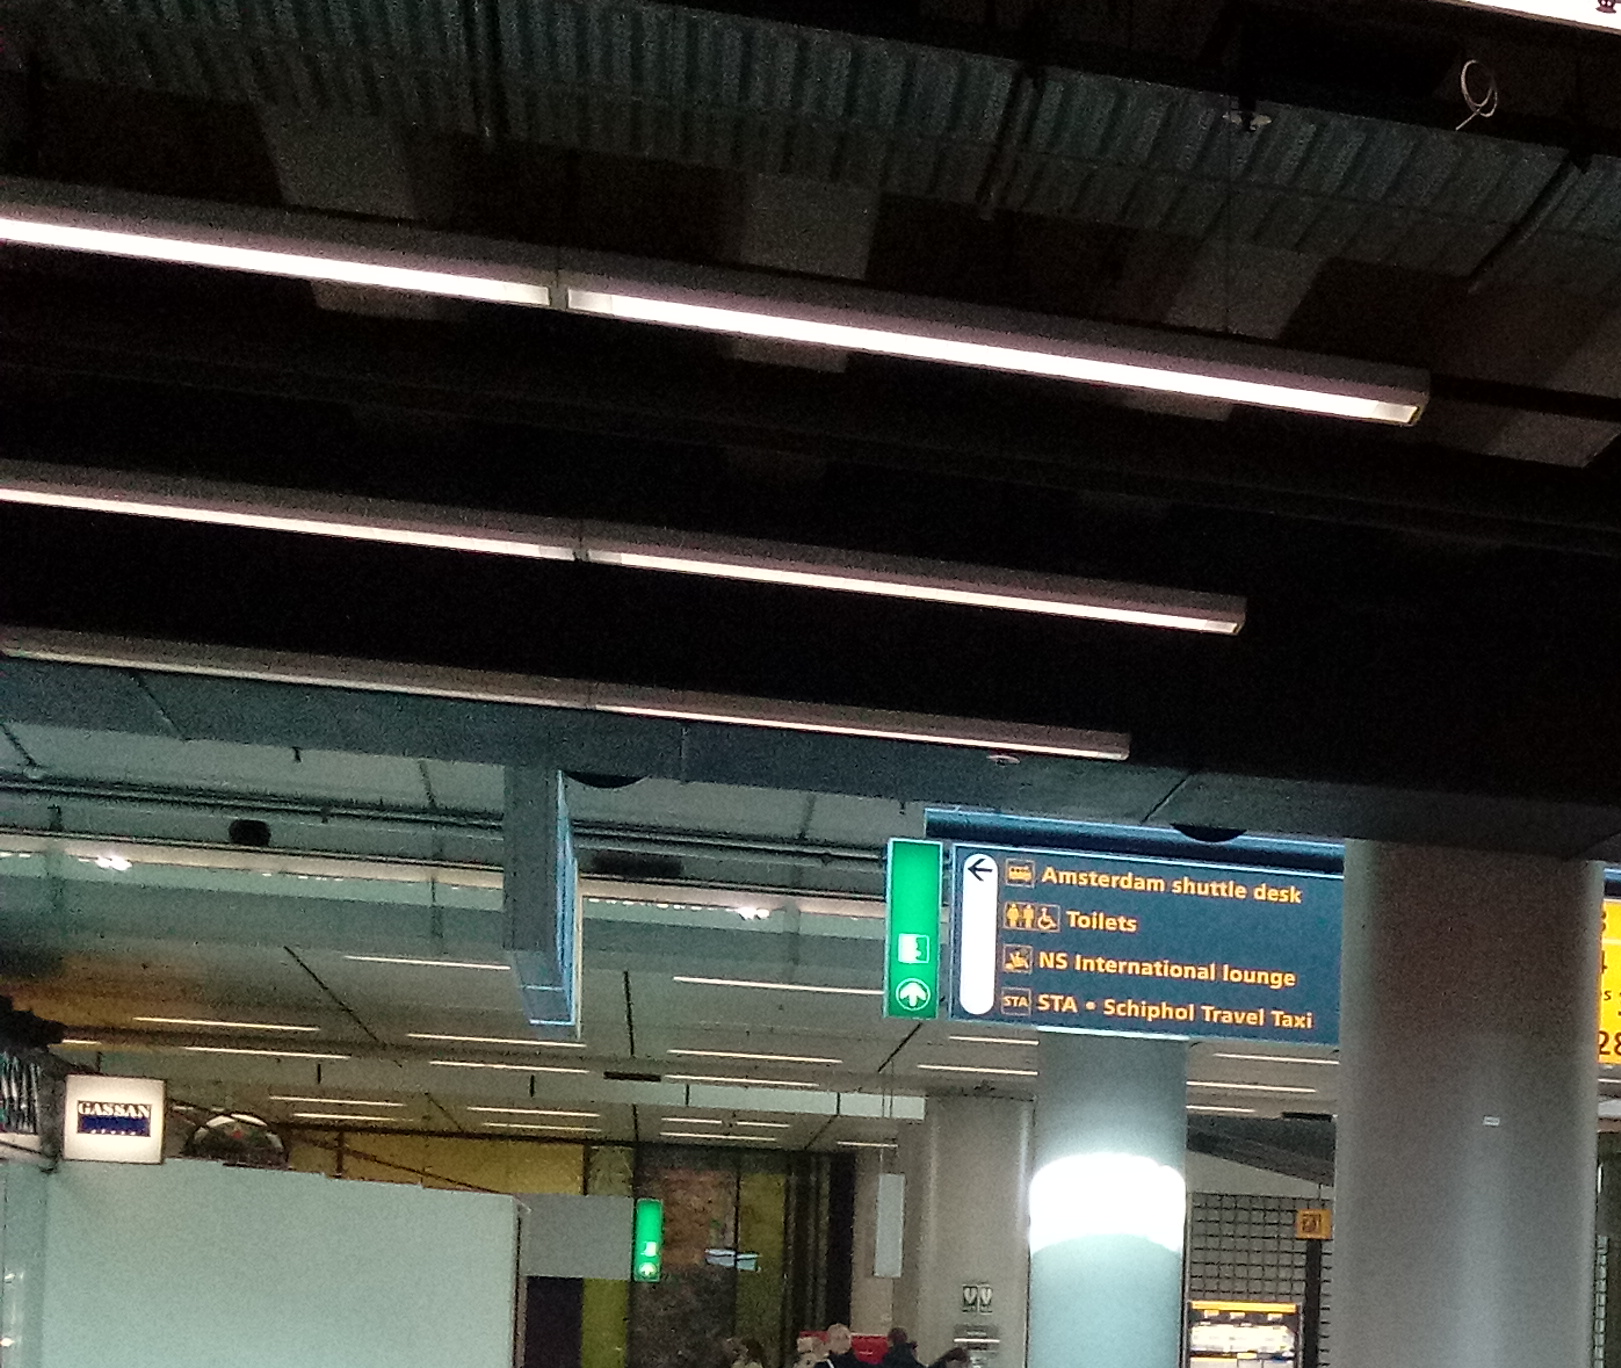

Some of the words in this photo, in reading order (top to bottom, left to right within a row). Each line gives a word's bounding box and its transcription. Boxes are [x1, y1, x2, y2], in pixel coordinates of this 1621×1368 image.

[1041, 866, 1166, 892] Amsterdam
[1171, 876, 1248, 899] shuttle
[1253, 882, 1303, 904] desk
[1065, 910, 1138, 932] Toilets
[1038, 951, 1068, 970] NS
[1074, 953, 1216, 981] International
[1222, 963, 1296, 990] lounge
[1003, 995, 1029, 1008] STA
[1037, 993, 1078, 1014] STA
[1102, 998, 1196, 1022] Schiphol
[1200, 1004, 1264, 1026] Travel
[1270, 1009, 1313, 1029] Taxi
[78, 1101, 150, 1119] GASSAN
